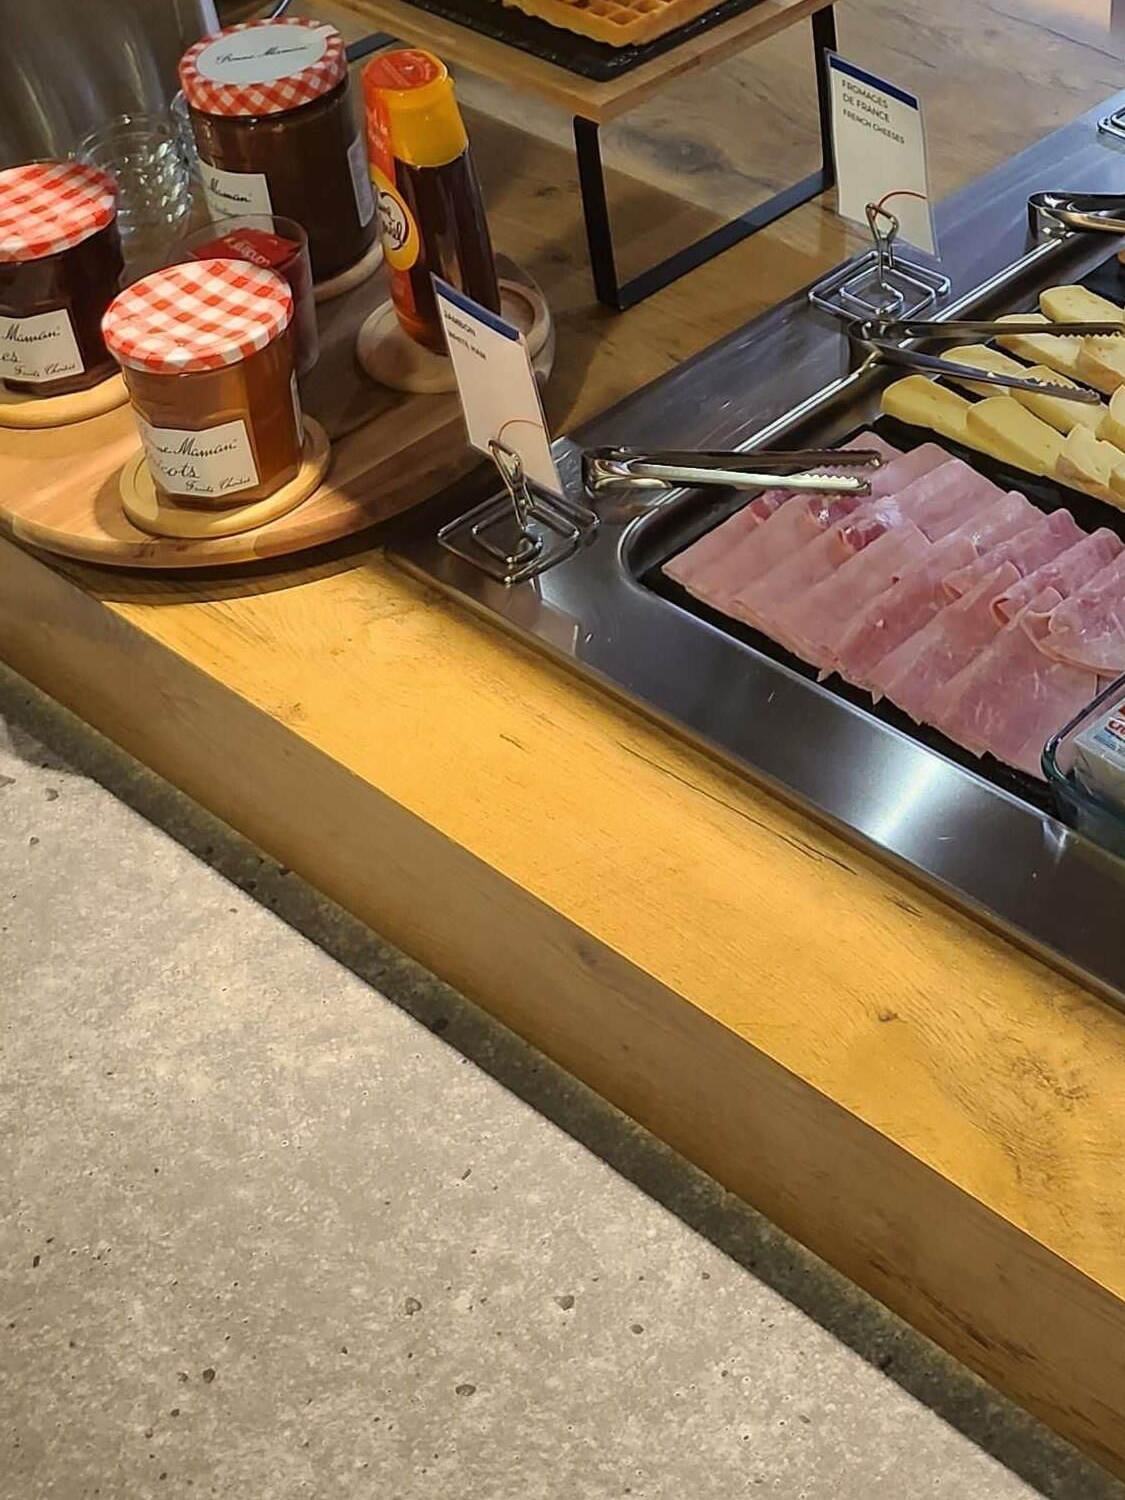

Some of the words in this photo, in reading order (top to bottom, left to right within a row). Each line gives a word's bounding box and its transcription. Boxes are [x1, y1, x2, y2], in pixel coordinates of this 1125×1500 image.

[842, 80, 888, 109] FROMAGES
[843, 93, 855, 105] DE
[857, 100, 890, 123] FRANCE
[843, 109, 871, 128] FRENCH
[872, 123, 904, 144] CHEESES
